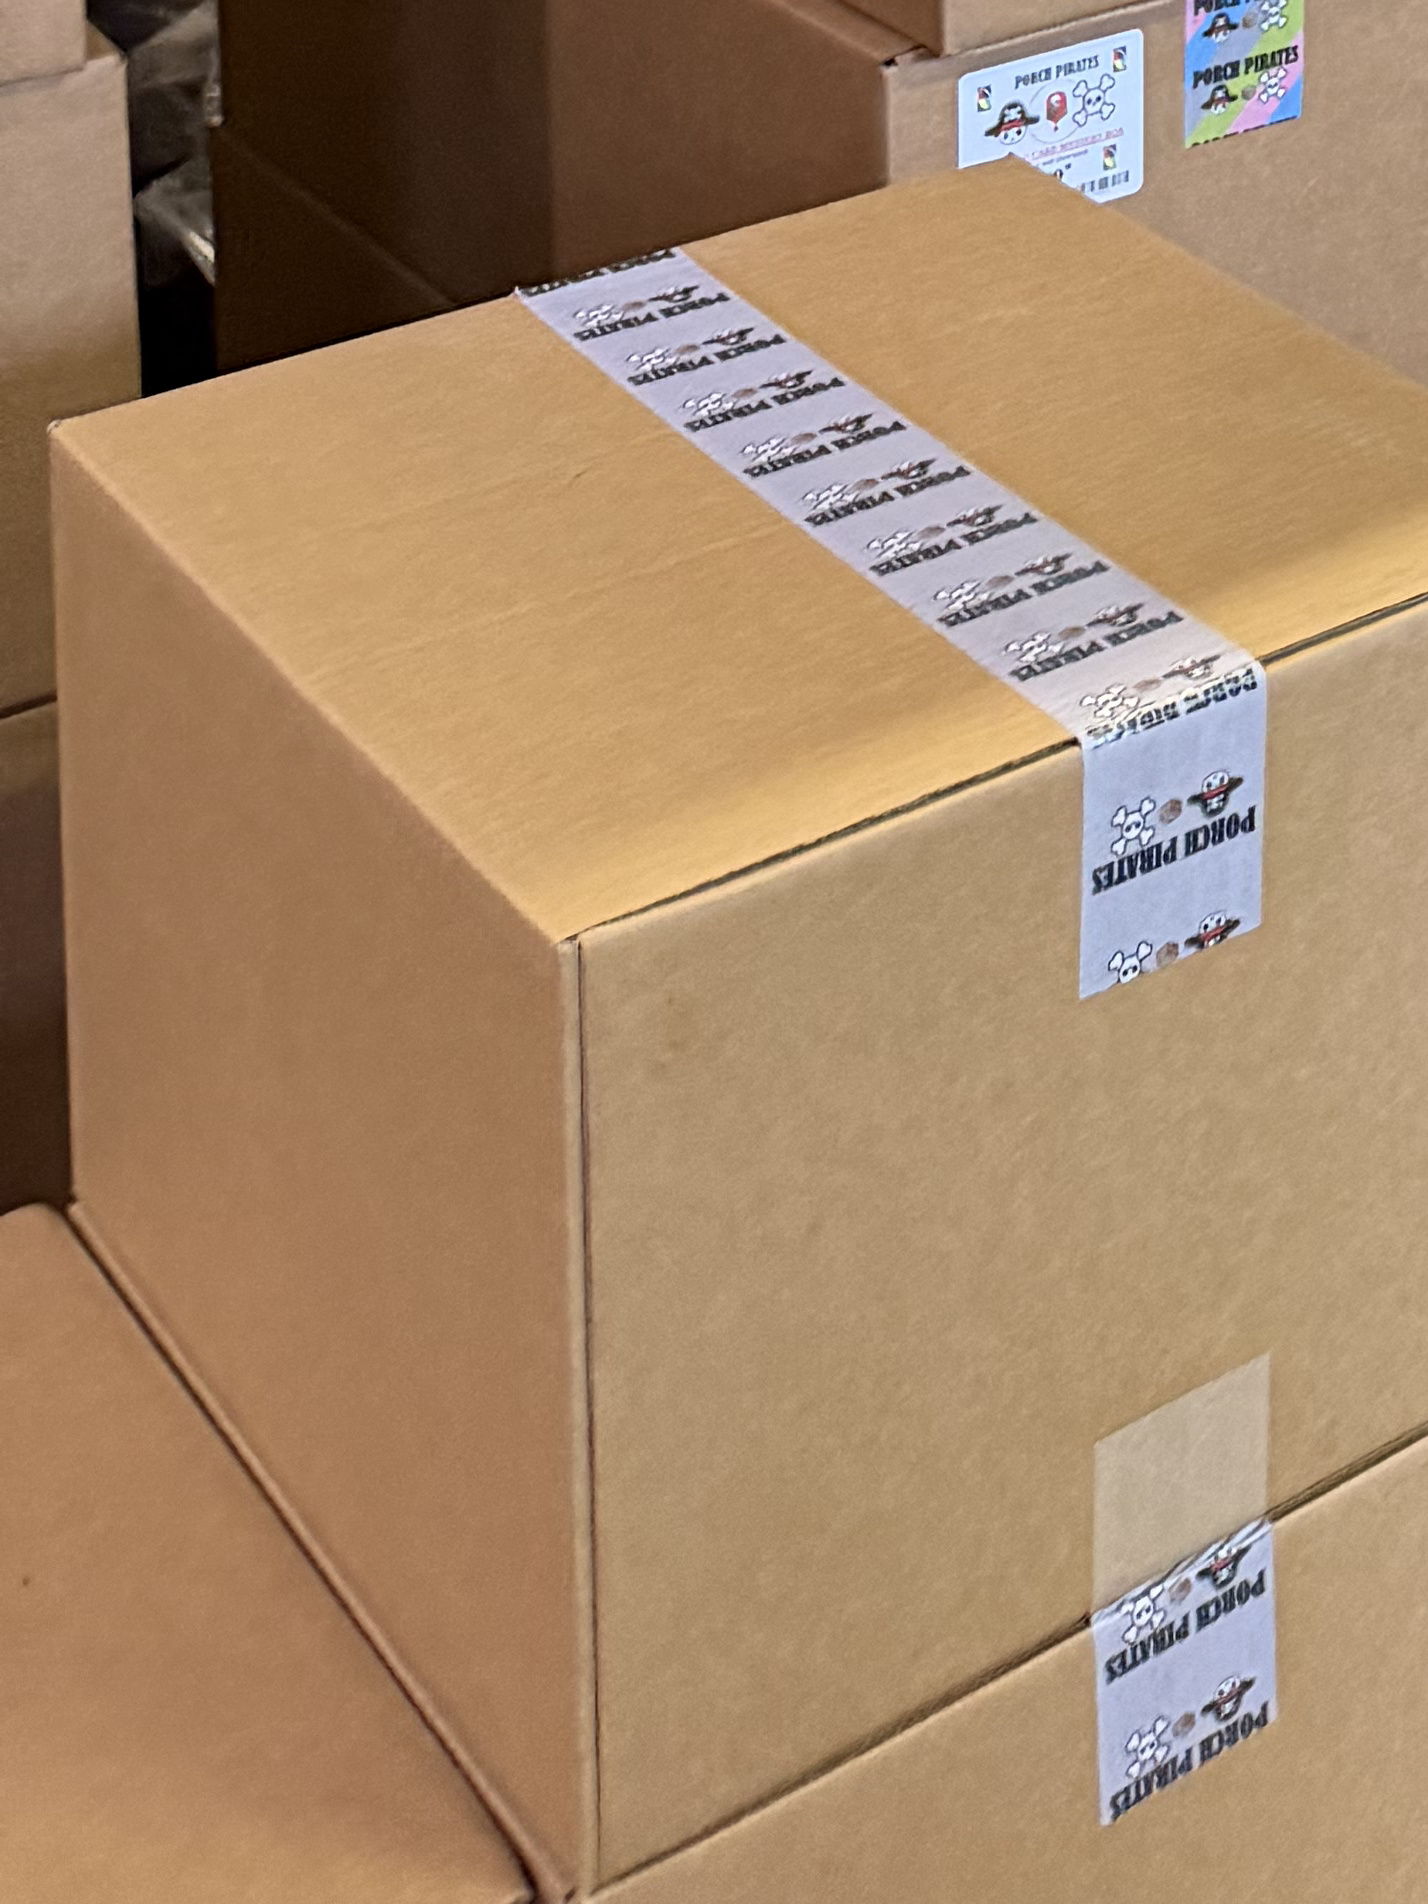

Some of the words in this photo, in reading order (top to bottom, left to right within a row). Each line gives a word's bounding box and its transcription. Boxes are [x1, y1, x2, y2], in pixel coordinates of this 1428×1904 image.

[1014, 68, 1053, 90] PORCH
[1056, 55, 1100, 77] PIRATES
[1192, 59, 1240, 89] PORCH
[1244, 46, 1298, 76] PIRATES
[1184, 805, 1256, 857] PORCH
[1092, 841, 1178, 895] PIRATES
[1196, 1568, 1266, 1633] PORCH
[1106, 1612, 1190, 1685] PIRATES
[1199, 1701, 1269, 1767] PORCH
[1110, 1748, 1193, 1822] PIRATES
